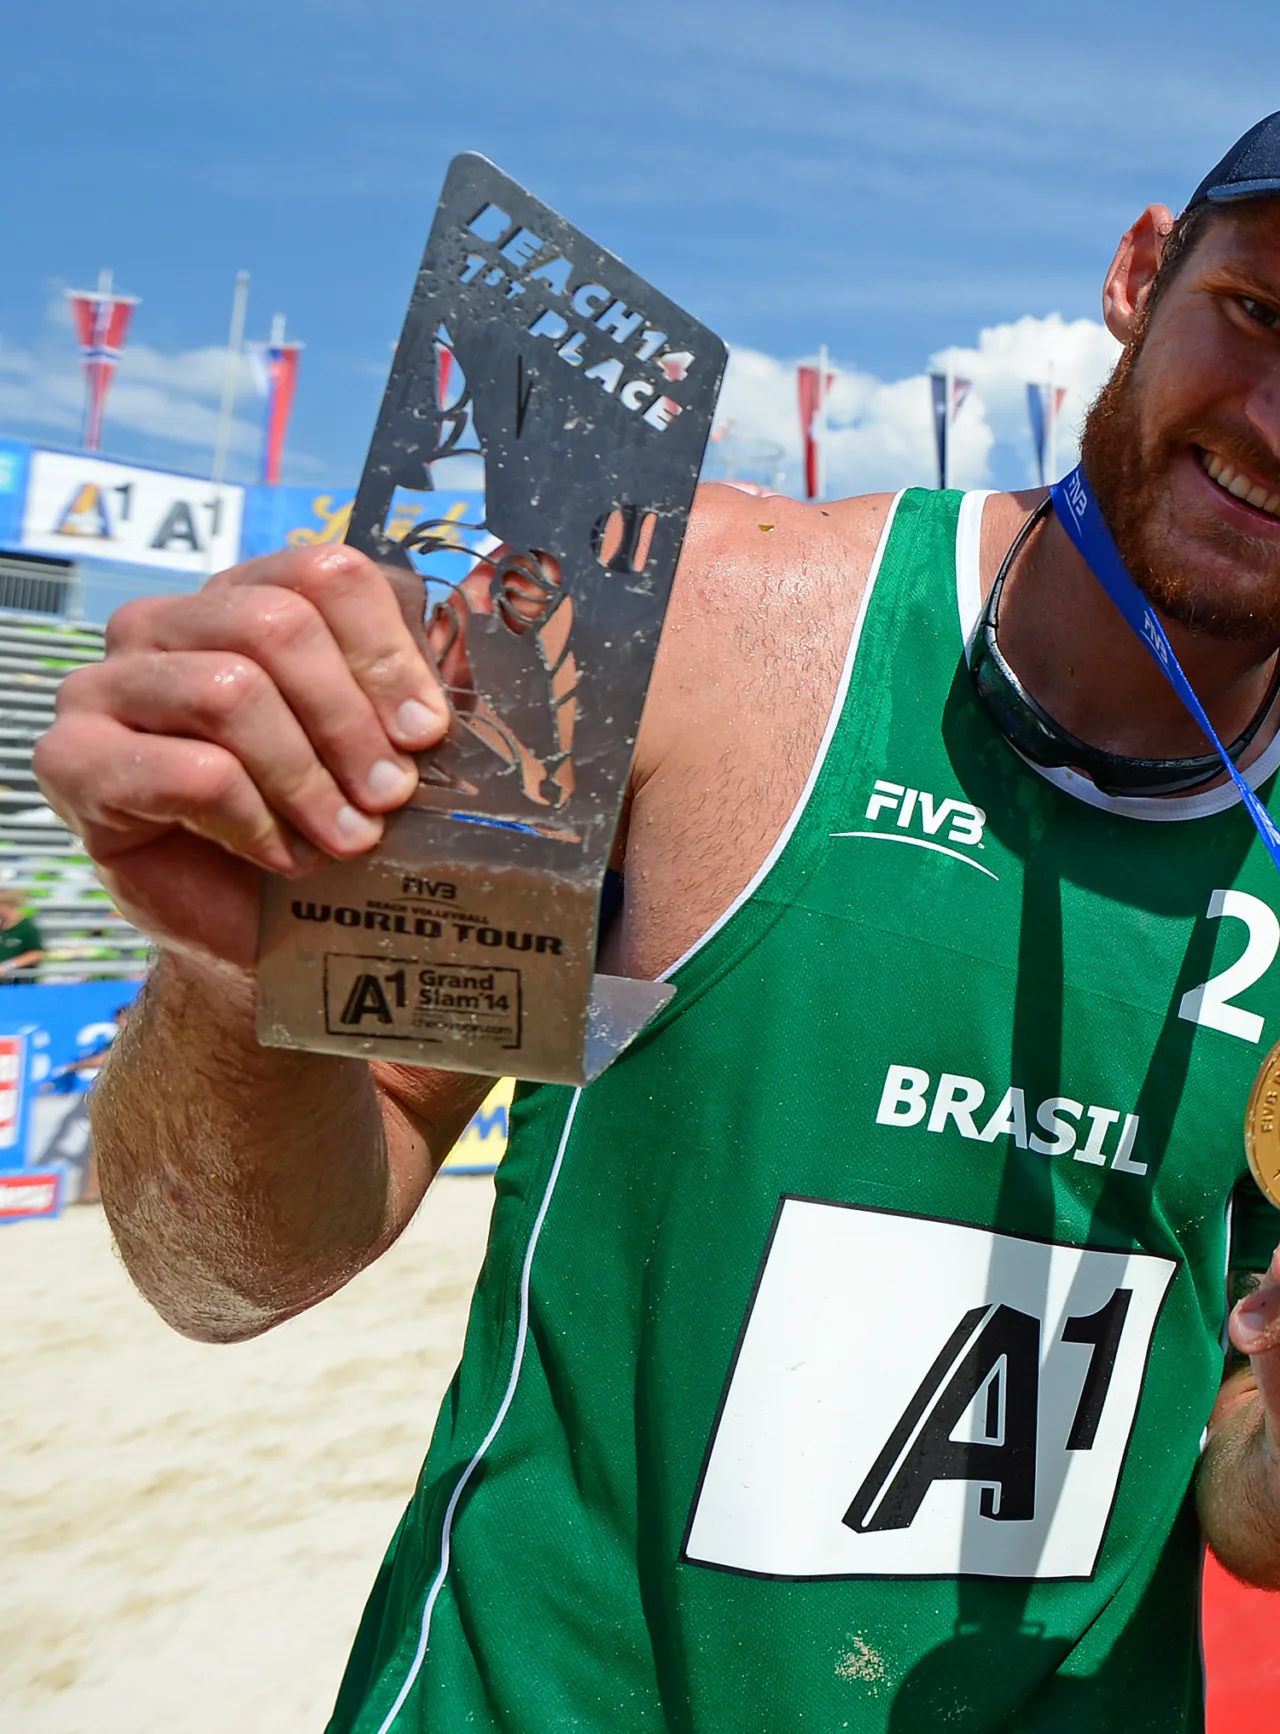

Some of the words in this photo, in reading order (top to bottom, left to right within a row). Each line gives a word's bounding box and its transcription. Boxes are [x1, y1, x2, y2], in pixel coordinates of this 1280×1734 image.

[528, 309, 683, 432] PLACE
[53, 483, 134, 540] A1
[150, 496, 222, 553] A1
[865, 779, 987, 848] FIVB
[402, 876, 458, 901] FIVB
[291, 901, 442, 940] WORLD
[452, 922, 563, 956] TOUR
[418, 969, 494, 991] Grand
[1178, 889, 1280, 1044] 2
[340, 968, 406, 1025] A1
[875, 1064, 1148, 1176] BRASIL
[1260, 1091, 1279, 1134] FIVB
[841, 1288, 1134, 1534] A1
